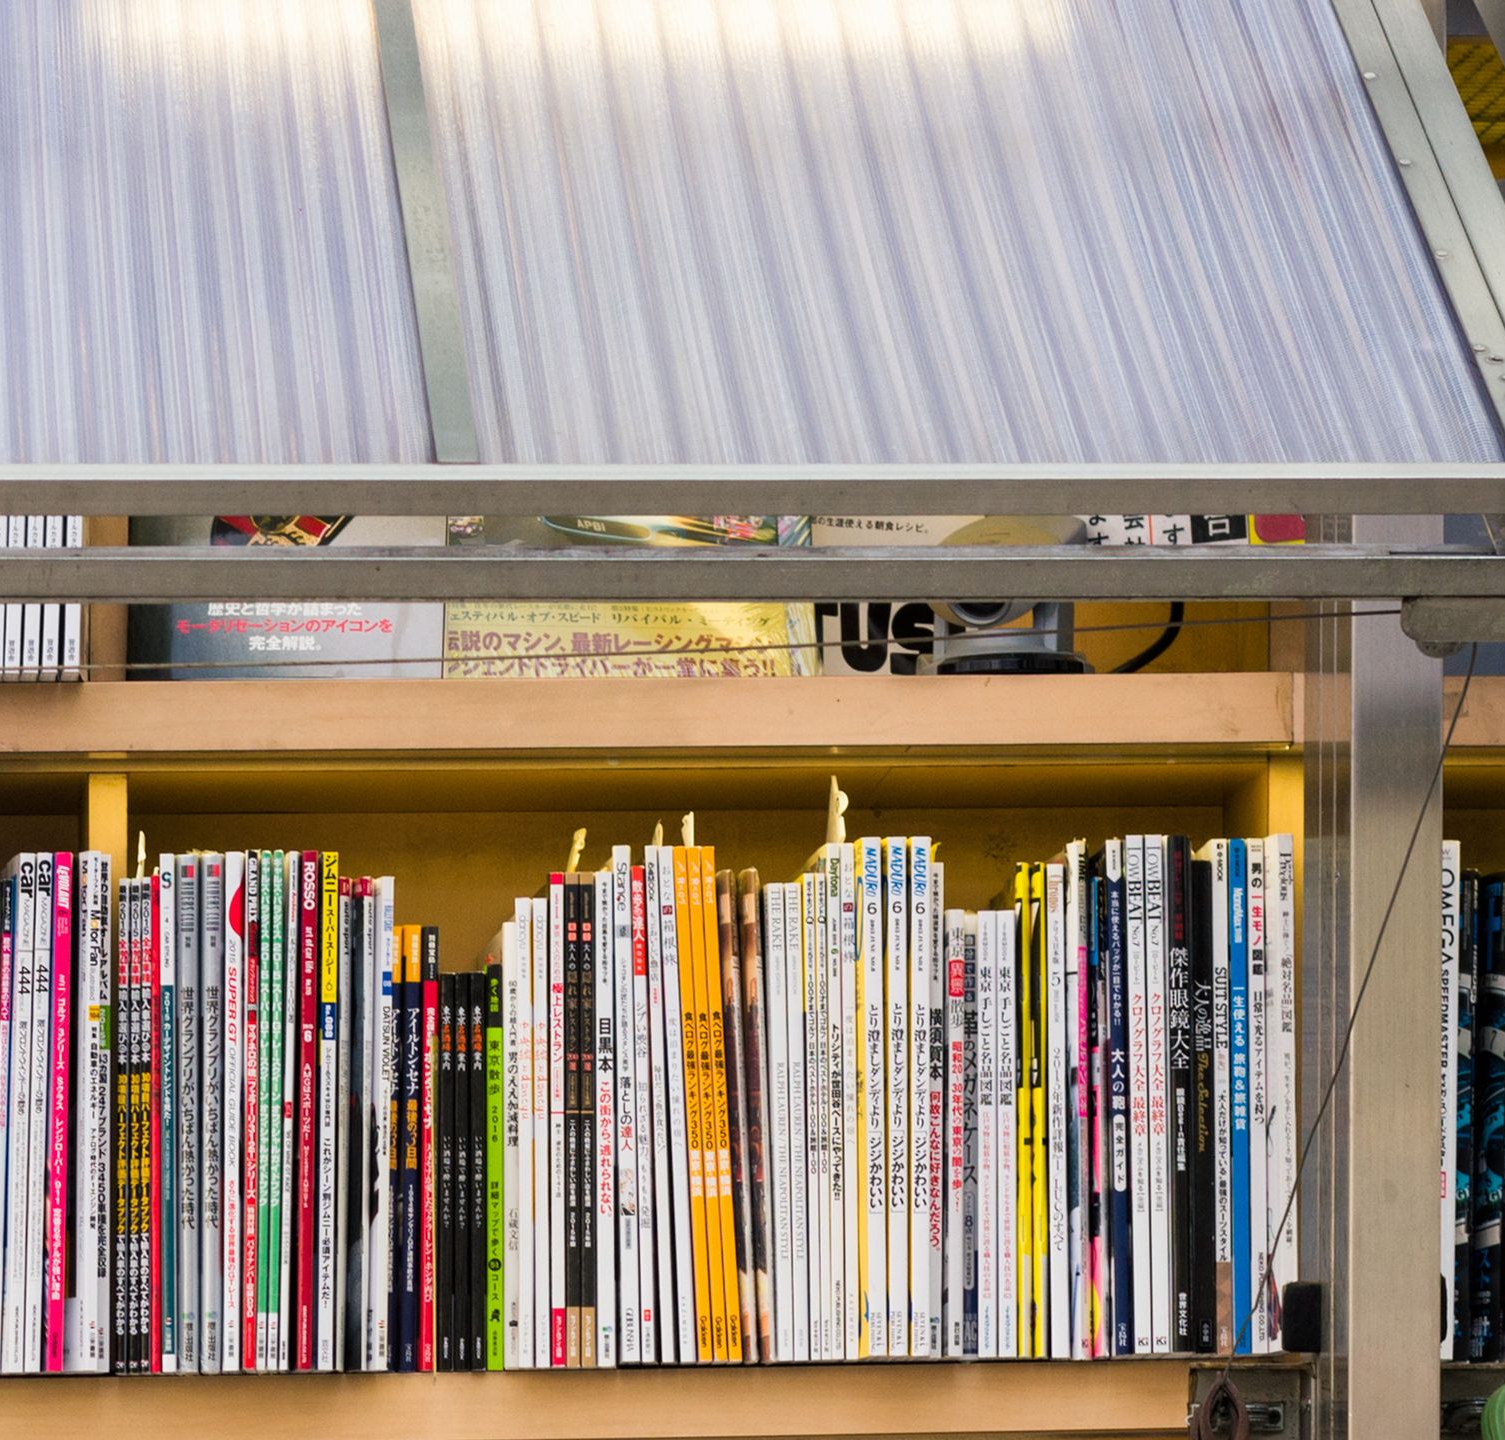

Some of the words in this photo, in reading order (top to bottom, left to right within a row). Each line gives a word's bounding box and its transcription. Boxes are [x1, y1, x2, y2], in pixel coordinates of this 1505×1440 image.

[249, 636, 323, 651] 完全解説。
[302, 864, 317, 910] ROSSO
[1168, 947, 1190, 1070] 傑作眼鏡大全
[597, 1017, 613, 1074] 目黒本
